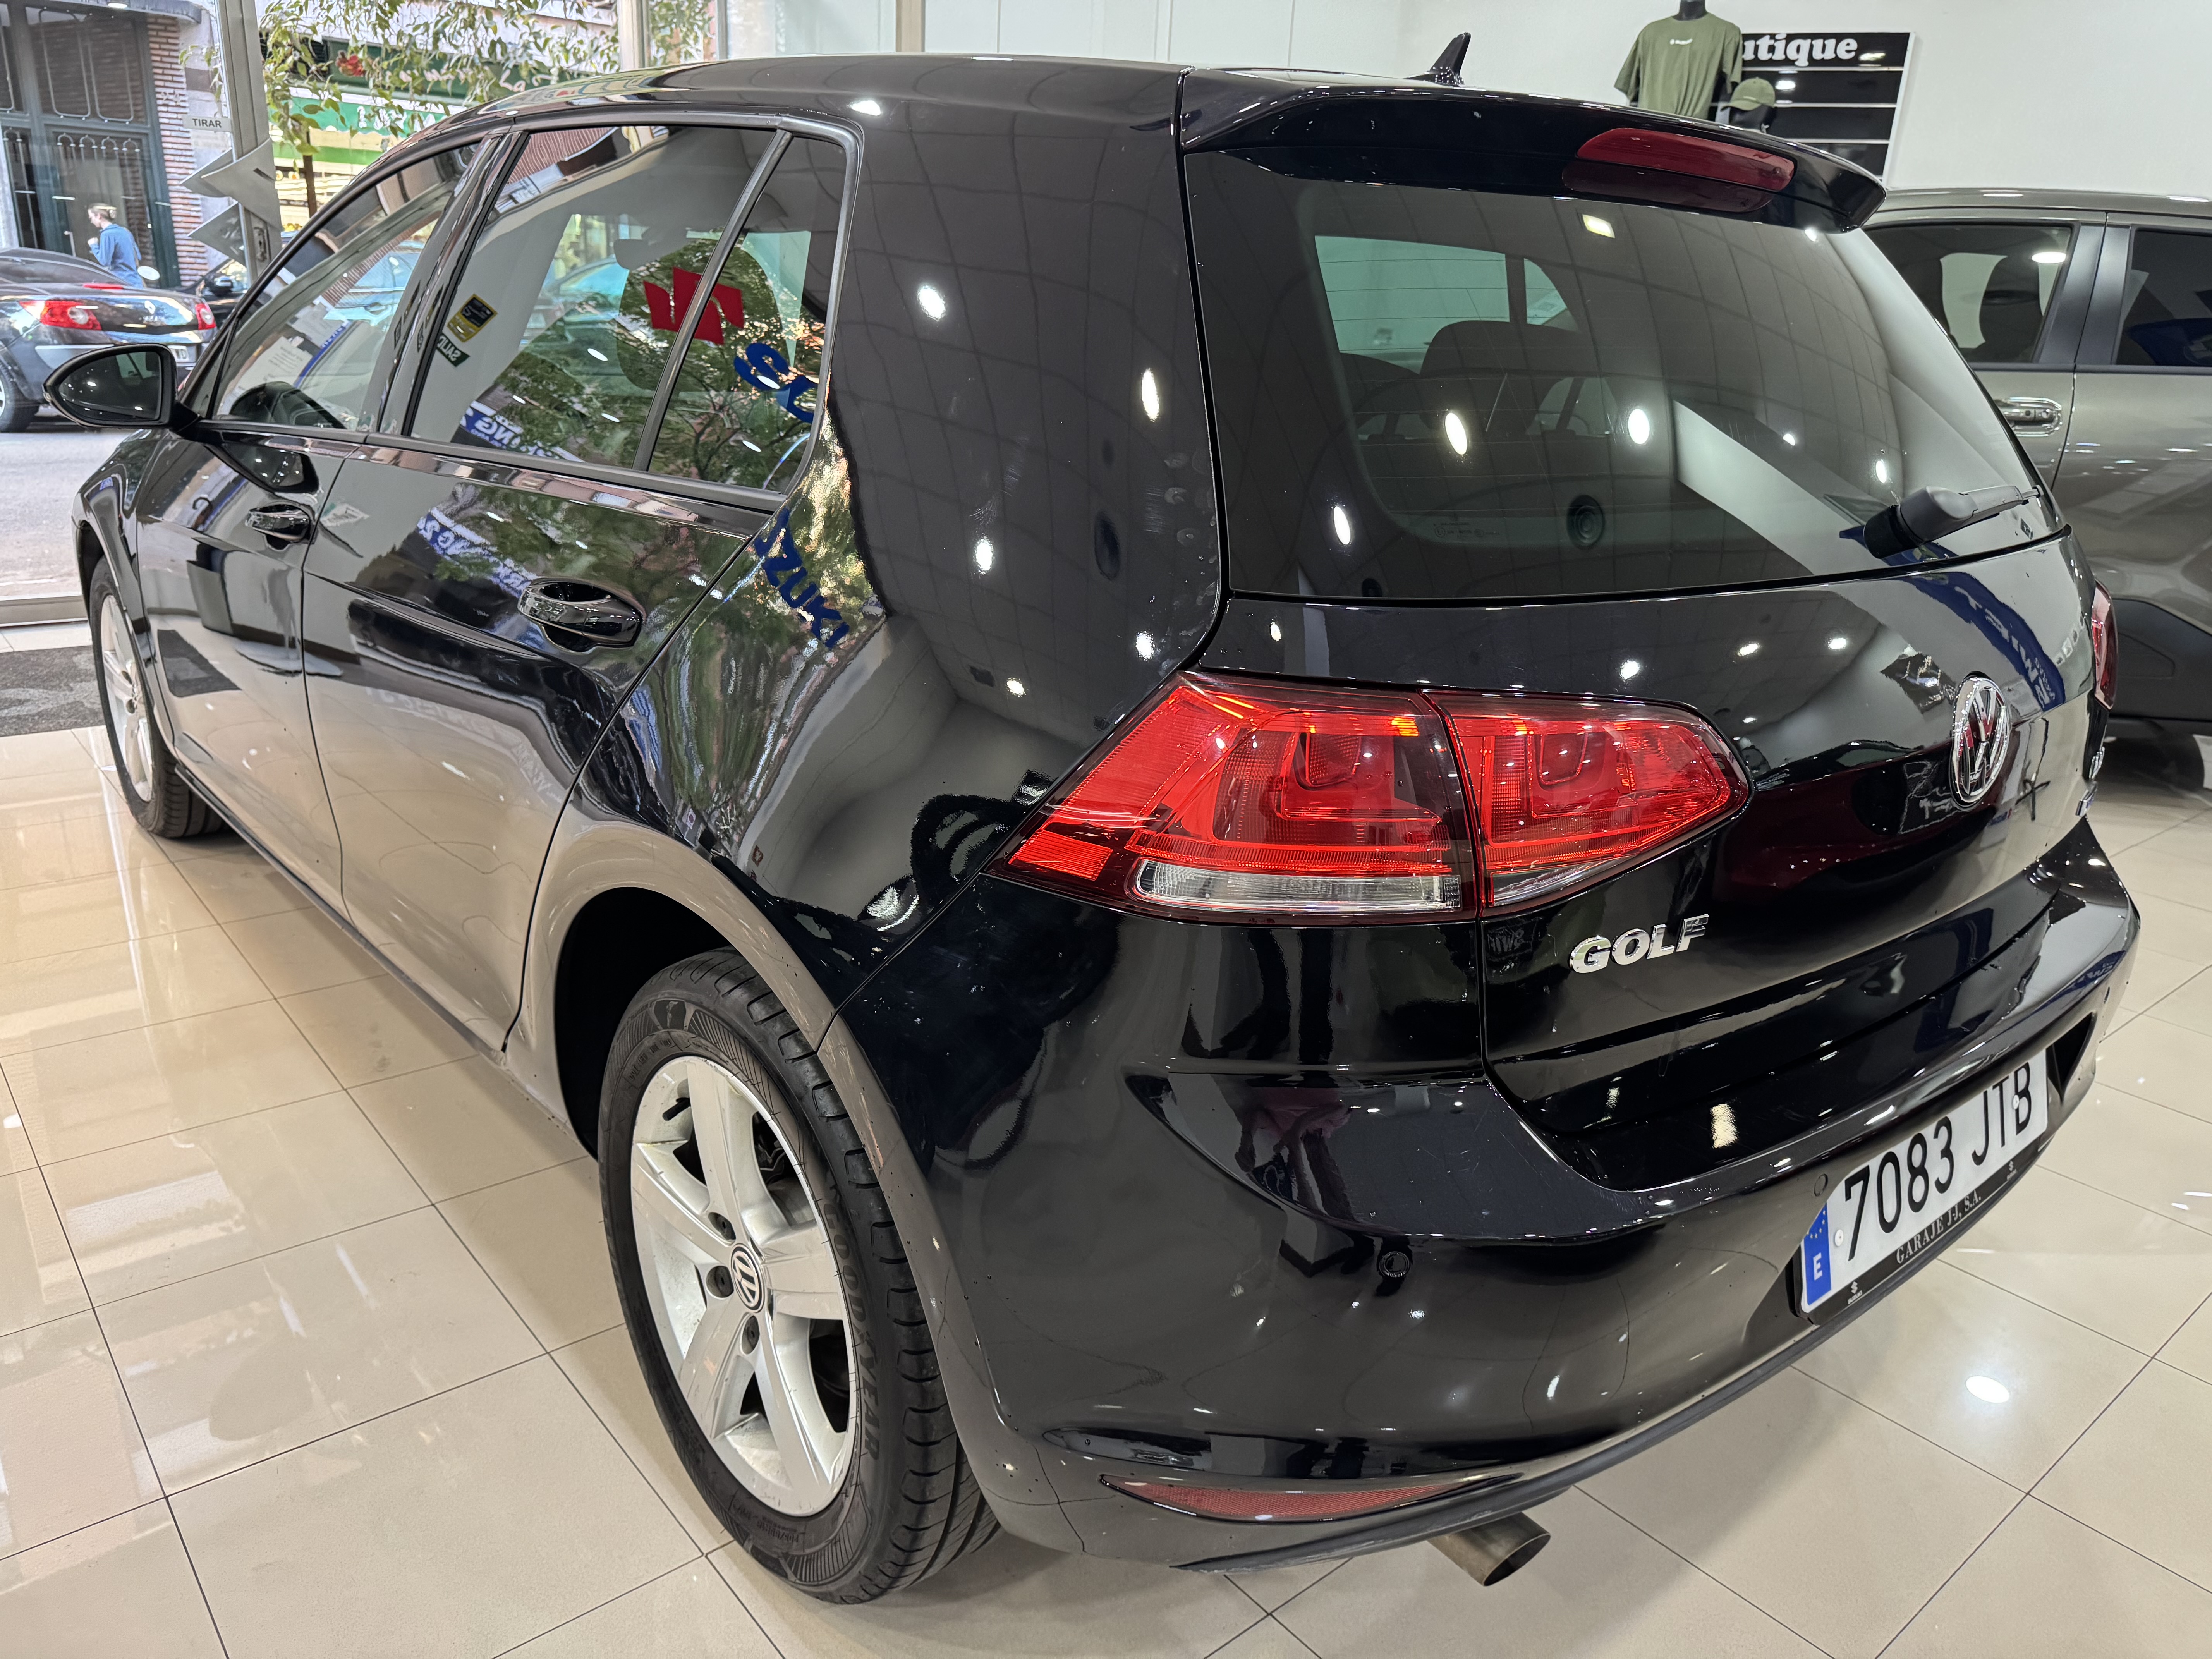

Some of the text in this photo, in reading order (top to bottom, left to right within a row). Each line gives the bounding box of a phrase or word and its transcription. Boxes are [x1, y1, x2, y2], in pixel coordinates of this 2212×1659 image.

[192, 118, 222, 128] TIRAR
[1569, 914, 1709, 974] GOLF
[1845, 1062, 2032, 1261] 7083 JTB
[1896, 1216, 1944, 1264] GARAJE
[1964, 1189, 1982, 1212] S.A.
[1813, 1252, 1822, 1281] E
[823, 1203, 880, 1461] GOODYEAR
